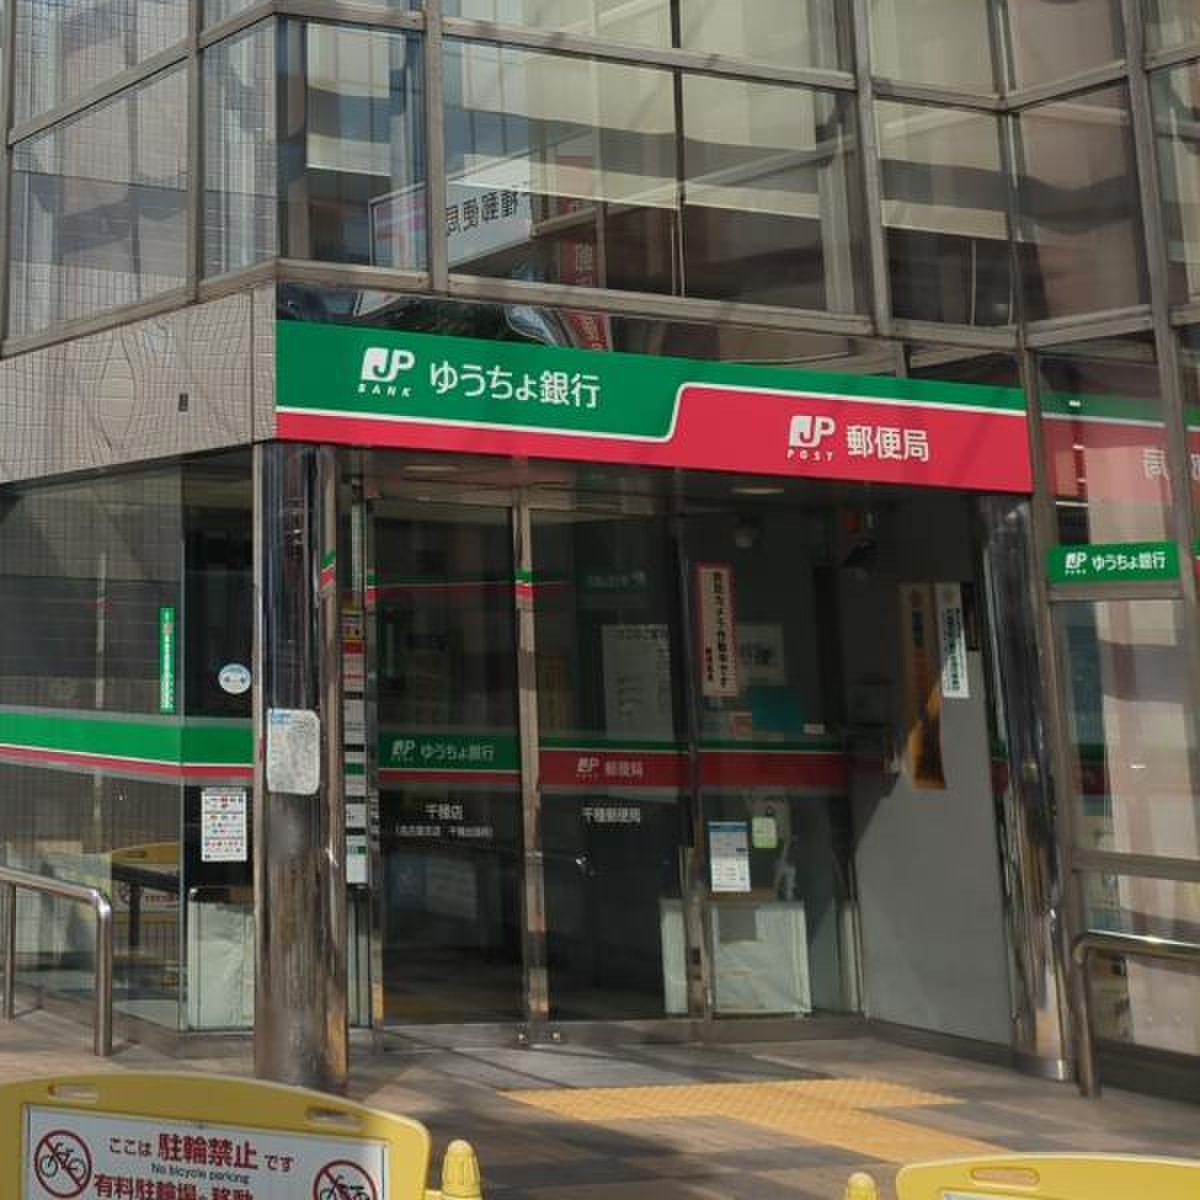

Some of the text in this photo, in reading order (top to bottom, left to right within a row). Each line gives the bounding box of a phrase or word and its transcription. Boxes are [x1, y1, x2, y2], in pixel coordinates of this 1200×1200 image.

[361, 348, 415, 382] JP
[357, 384, 412, 398] BANK
[430, 361, 601, 409] ゆうちょ銀行
[788, 415, 835, 449] JP
[846, 424, 930, 463] 郵便局
[1092, 552, 1167, 571] ゆうちょ銀行
[151, 1163, 167, 1174] No
